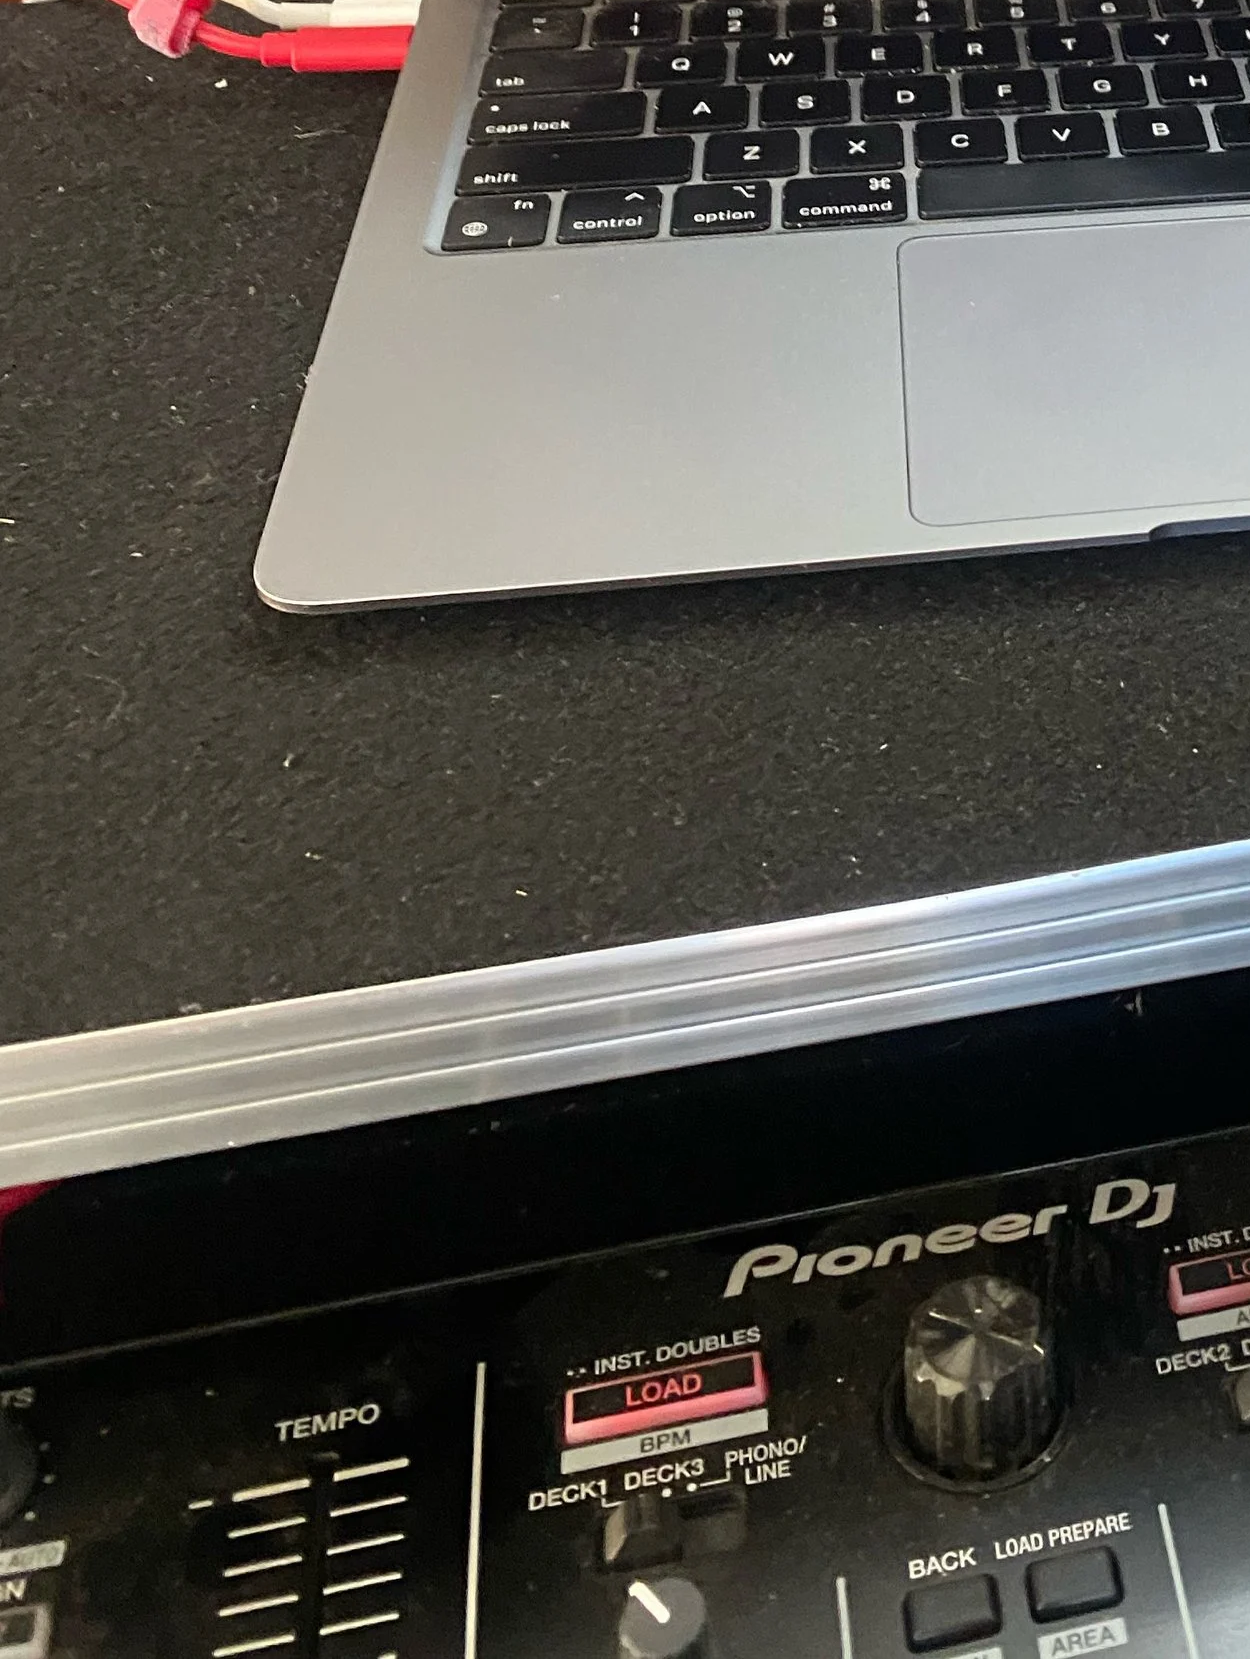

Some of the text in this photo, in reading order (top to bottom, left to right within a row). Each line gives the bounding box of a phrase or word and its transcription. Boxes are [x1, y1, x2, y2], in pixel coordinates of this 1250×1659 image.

[496, 76, 524, 87] tab
[486, 119, 569, 135] caps lock
[474, 171, 518, 184] shift
[513, 199, 533, 210] fn
[693, 208, 755, 223] option
[799, 201, 892, 216] command
[573, 215, 642, 229] control
[723, 1205, 1068, 1298] Pioneer
[1188, 1230, 1240, 1253] INST.
[594, 1326, 761, 1375] INST. DOUBLES
[1156, 1345, 1230, 1375] DECK2
[625, 1375, 702, 1407] LOAD
[275, 1403, 381, 1441] TEMPO
[640, 1430, 691, 1454] BPM
[725, 1435, 807, 1468] PHONO/
[625, 1459, 704, 1490] DECK3
[745, 1461, 790, 1484] LINE
[528, 1480, 607, 1511] DECK1
[994, 1513, 1132, 1560] LOAD PREPARE
[908, 1548, 976, 1579] BACK
[1051, 1626, 1116, 1655] AREA
